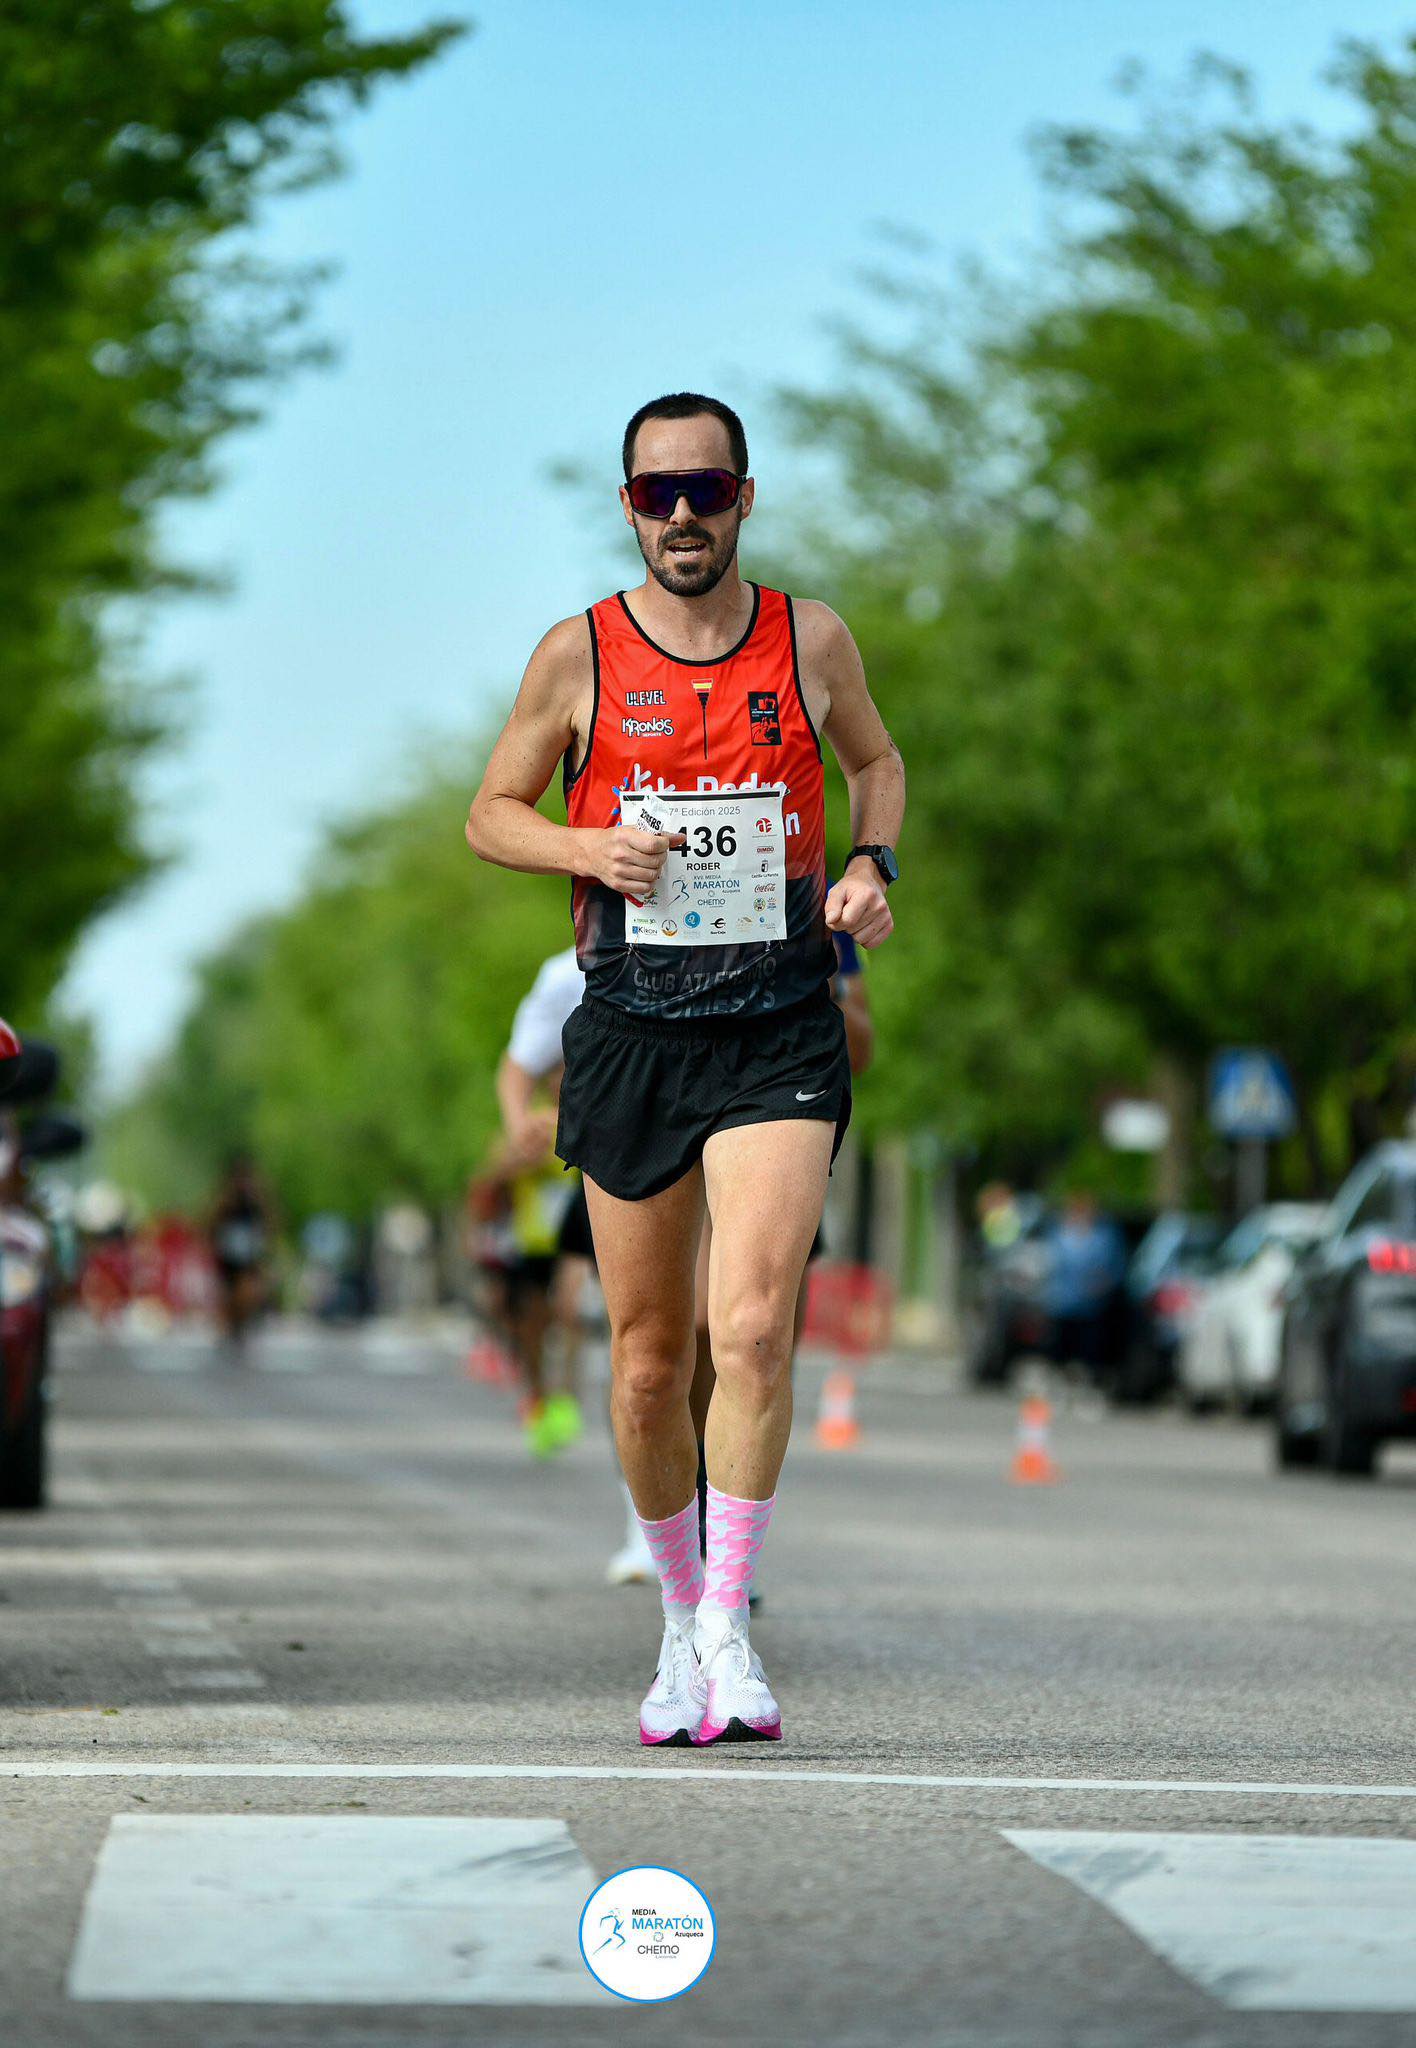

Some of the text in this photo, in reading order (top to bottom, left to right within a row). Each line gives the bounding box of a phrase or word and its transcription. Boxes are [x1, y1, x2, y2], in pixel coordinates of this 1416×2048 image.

[681, 807, 715, 817] Edición
[717, 806, 741, 816] 2025
[669, 825, 737, 858] 436
[686, 862, 721, 871] ROBER
[693, 878, 740, 889] MARATÓN
[633, 967, 676, 993] CLUB
